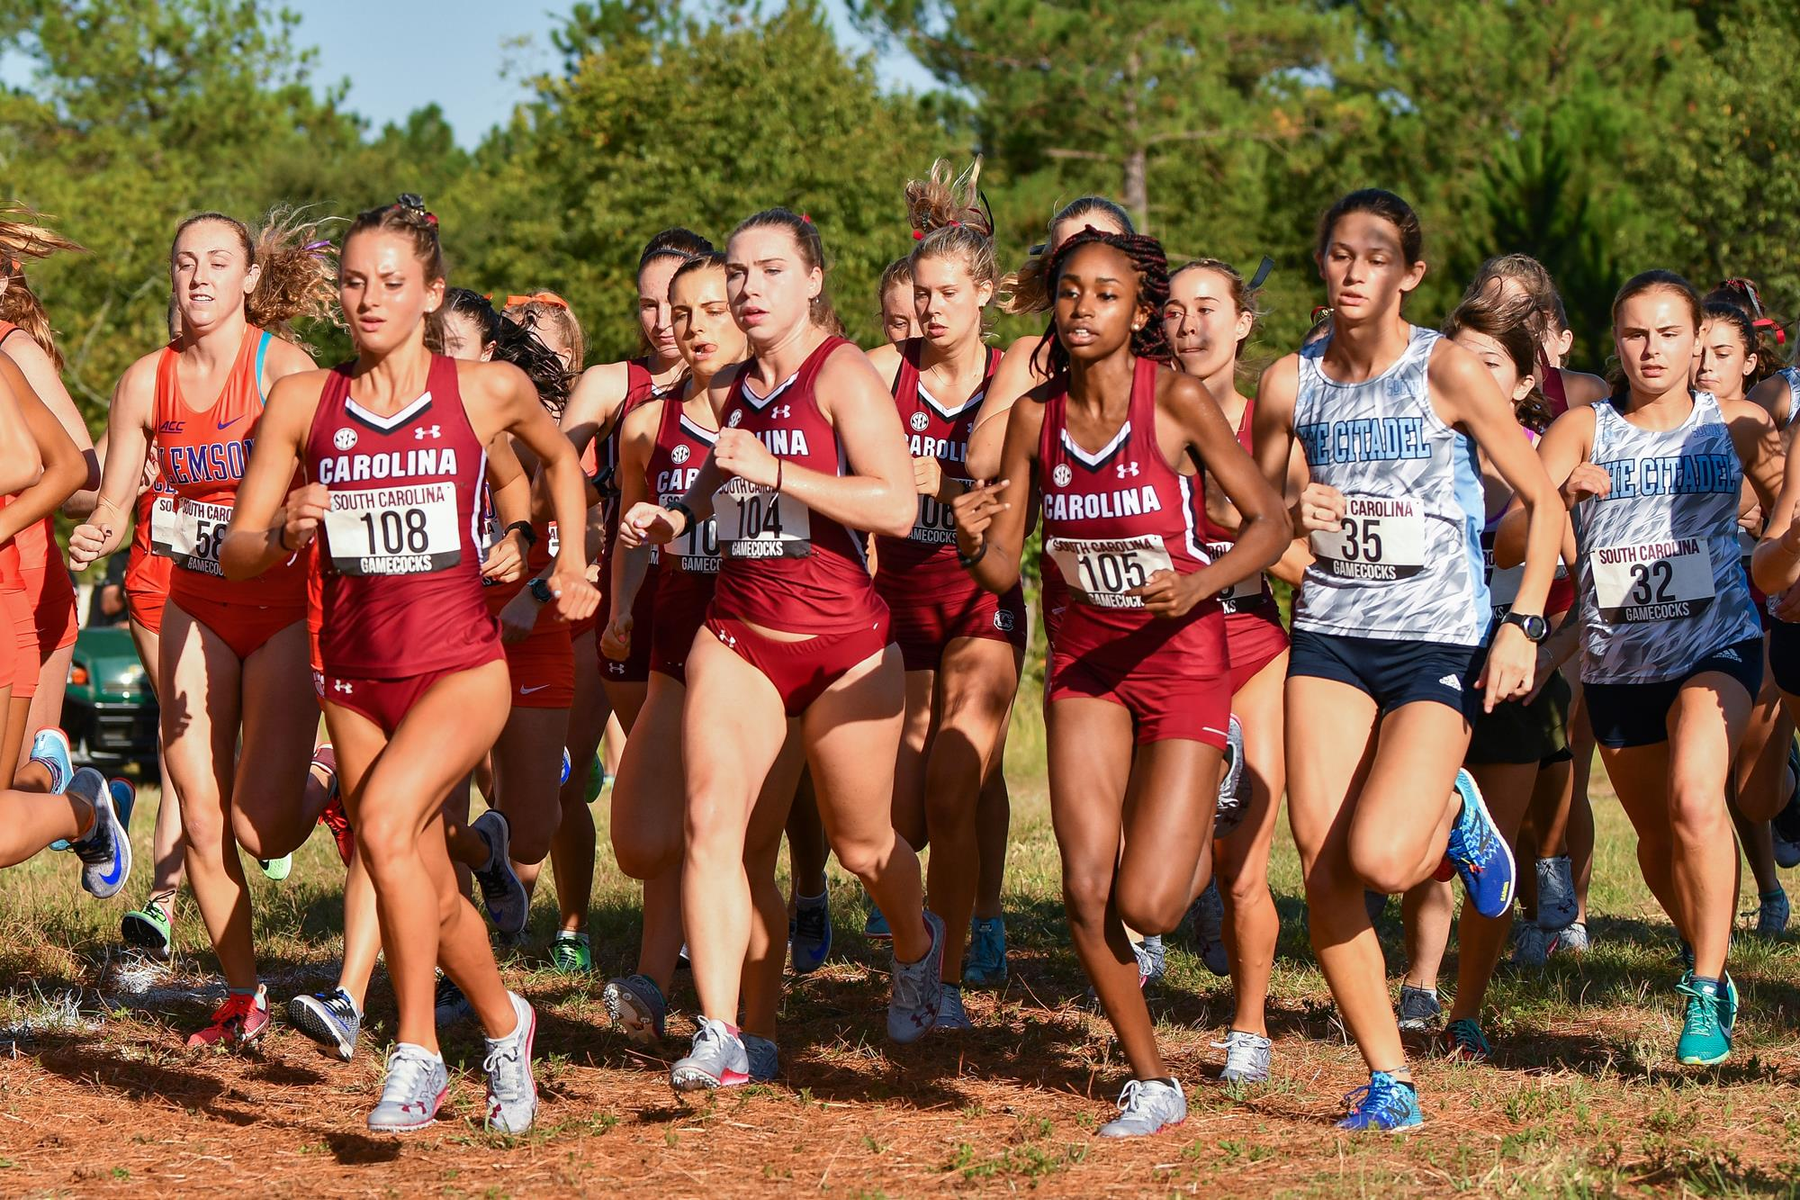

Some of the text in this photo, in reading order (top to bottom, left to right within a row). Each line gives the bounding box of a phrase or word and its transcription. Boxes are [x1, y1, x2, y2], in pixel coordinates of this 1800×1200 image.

[160, 421, 186, 432] ACC
[905, 434, 967, 462] AROLI
[1333, 417, 1432, 463] CITADEL
[158, 438, 256, 486] LEMSO
[319, 448, 457, 484] CAROLINA
[672, 446, 689, 463] SEC
[1640, 454, 1737, 497] CITADEL
[333, 486, 445, 511] SOUTH CAROLINA
[1043, 485, 1163, 521] CAROLINA
[1350, 500, 1413, 518] CAROLINA
[206, 505, 233, 523] CARO
[737, 496, 783, 539] 104
[195, 519, 228, 561] 58
[360, 509, 429, 555] 108
[689, 518, 721, 556] 10
[898, 528, 957, 544] AMECOCKS
[1341, 517, 1382, 563] 35
[731, 541, 784, 557] GAMECOCKS
[1052, 538, 1154, 555] SOUTH CAROLINA
[1599, 538, 1700, 565] SOUTH CAROLINA
[187, 556, 224, 577] GAMECO
[360, 555, 433, 574] GAMECOCKS
[681, 556, 723, 571] GAMEC
[1079, 552, 1146, 593] 105
[1333, 560, 1397, 581] GAMECOCKS
[1630, 560, 1677, 605] 32
[1087, 593, 1146, 608] GAMECOCK
[1625, 601, 1690, 622] GAMECOCKS
